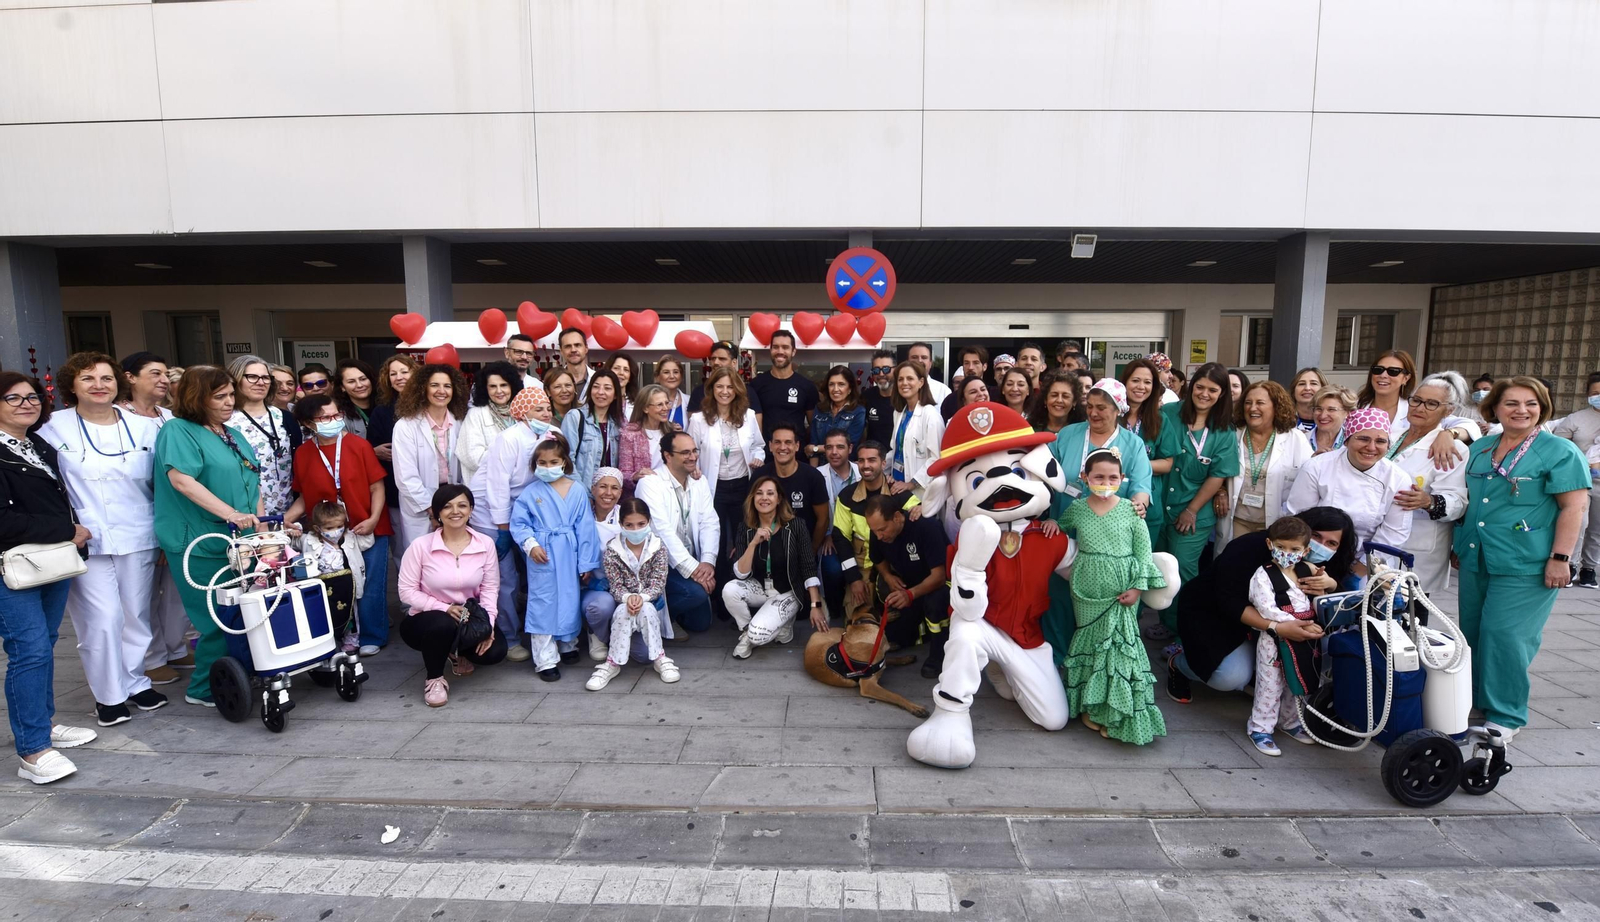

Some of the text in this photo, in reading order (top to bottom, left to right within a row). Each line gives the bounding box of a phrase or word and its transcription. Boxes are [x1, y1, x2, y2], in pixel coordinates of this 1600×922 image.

[227, 344, 250, 352] VISITAS
[301, 350, 329, 358] Acceso
[1113, 351, 1143, 360] Acceso
